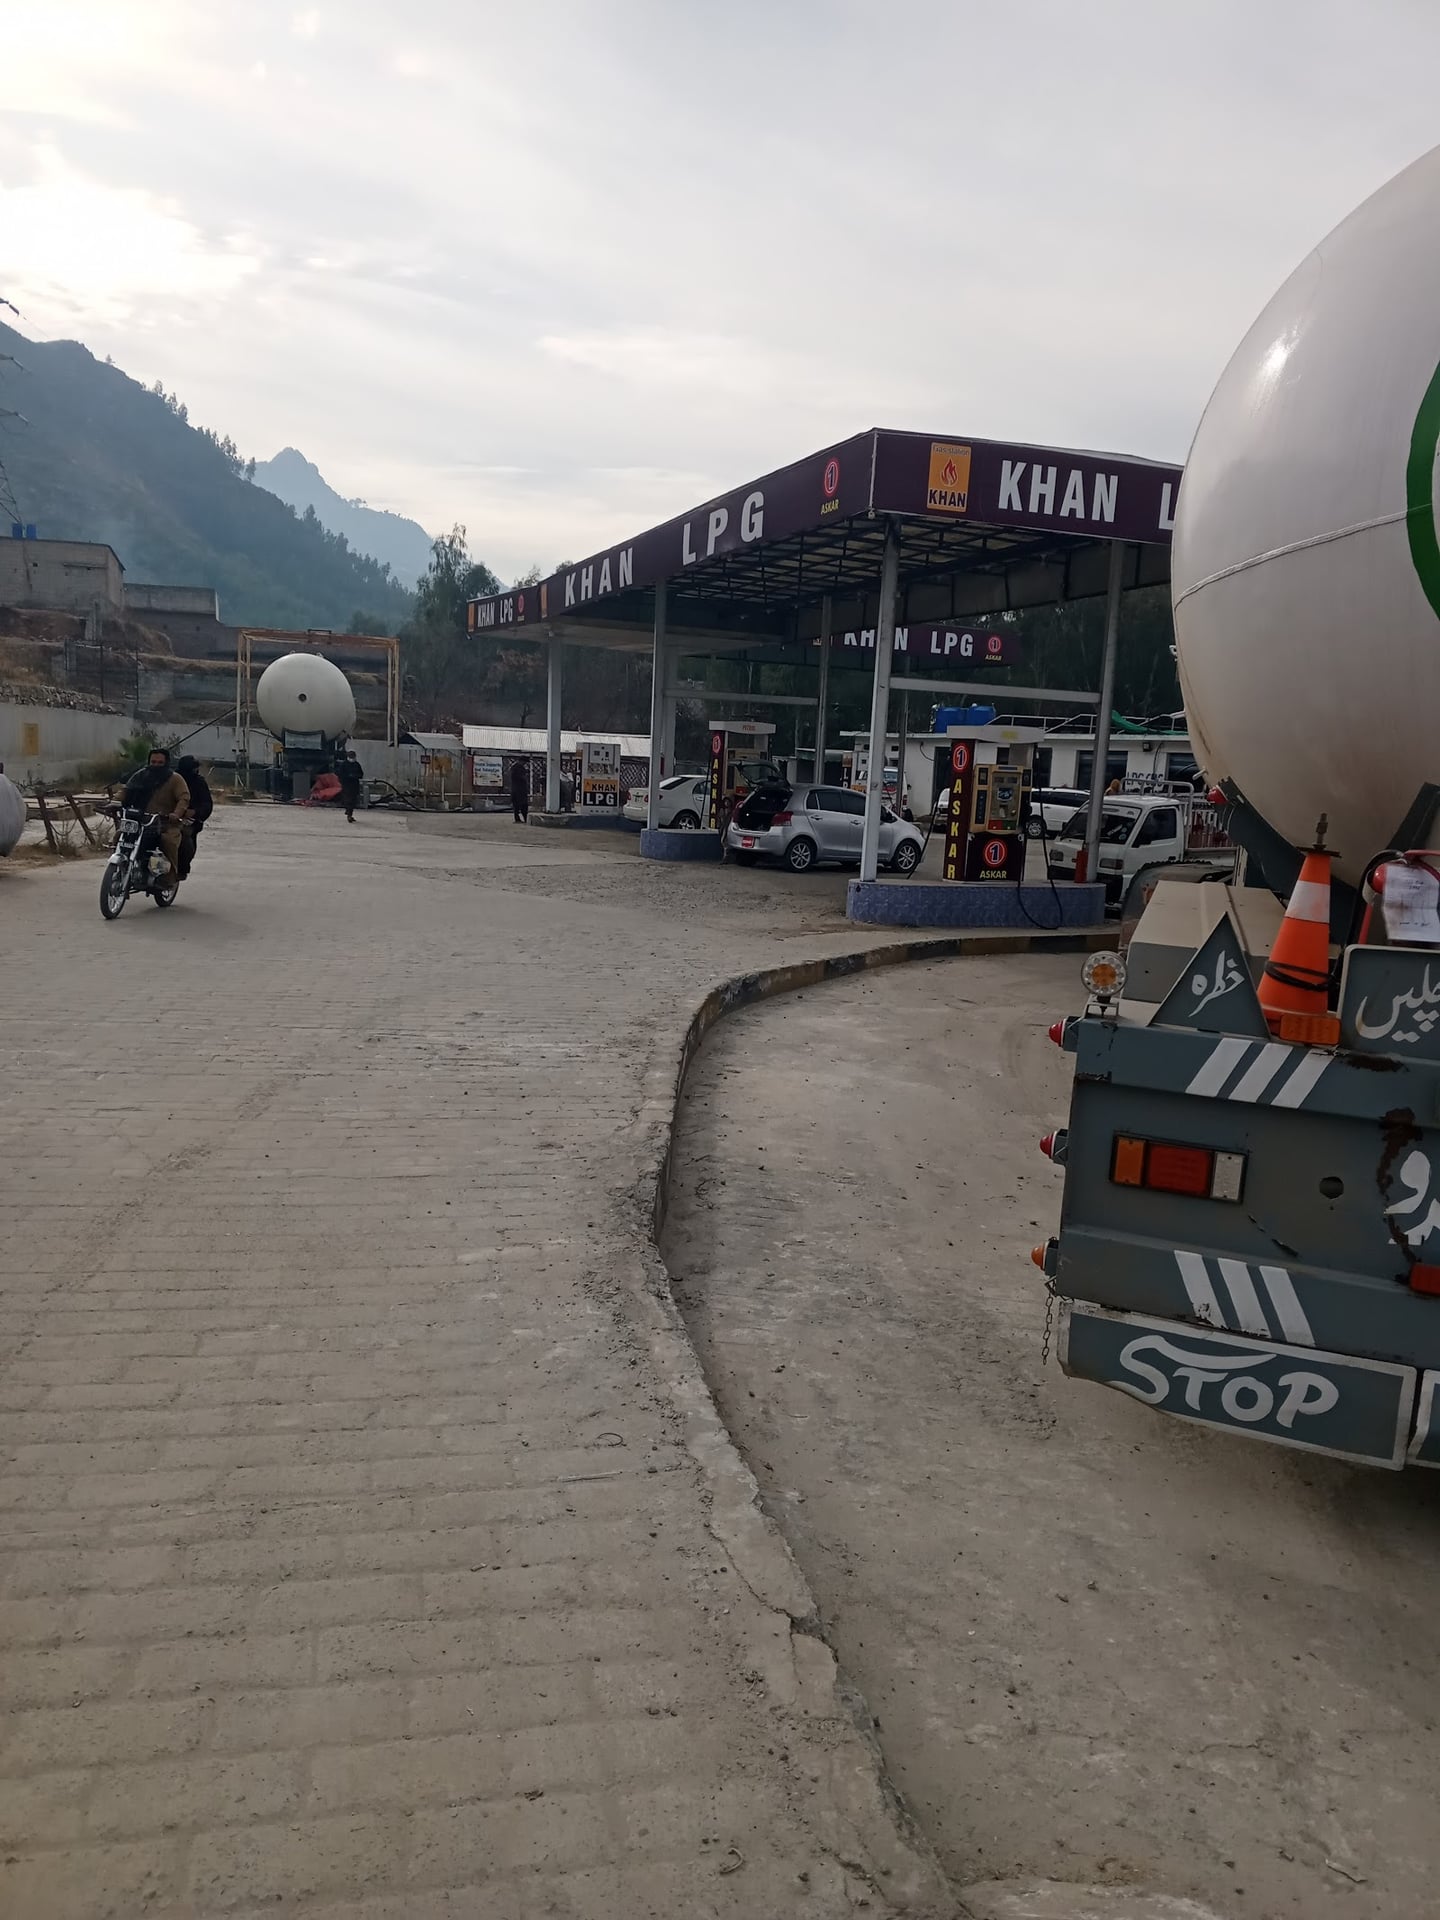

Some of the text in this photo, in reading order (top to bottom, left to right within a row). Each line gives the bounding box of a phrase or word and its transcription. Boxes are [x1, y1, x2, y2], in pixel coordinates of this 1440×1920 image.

[929, 489, 966, 507] KHAN
[998, 459, 1118, 523] KHAN
[820, 499, 839, 516] ASKAR
[564, 491, 764, 607] KHAN LPG
[477, 597, 514, 628] KHAN LPG
[844, 627, 974, 657] KHN LPG
[586, 793, 614, 805] LPG
[591, 784, 616, 792] KHAN
[947, 778, 963, 879] ASKAR
[979, 870, 1007, 879] ASKAR
[1104, 1334, 1340, 1428] STOP
